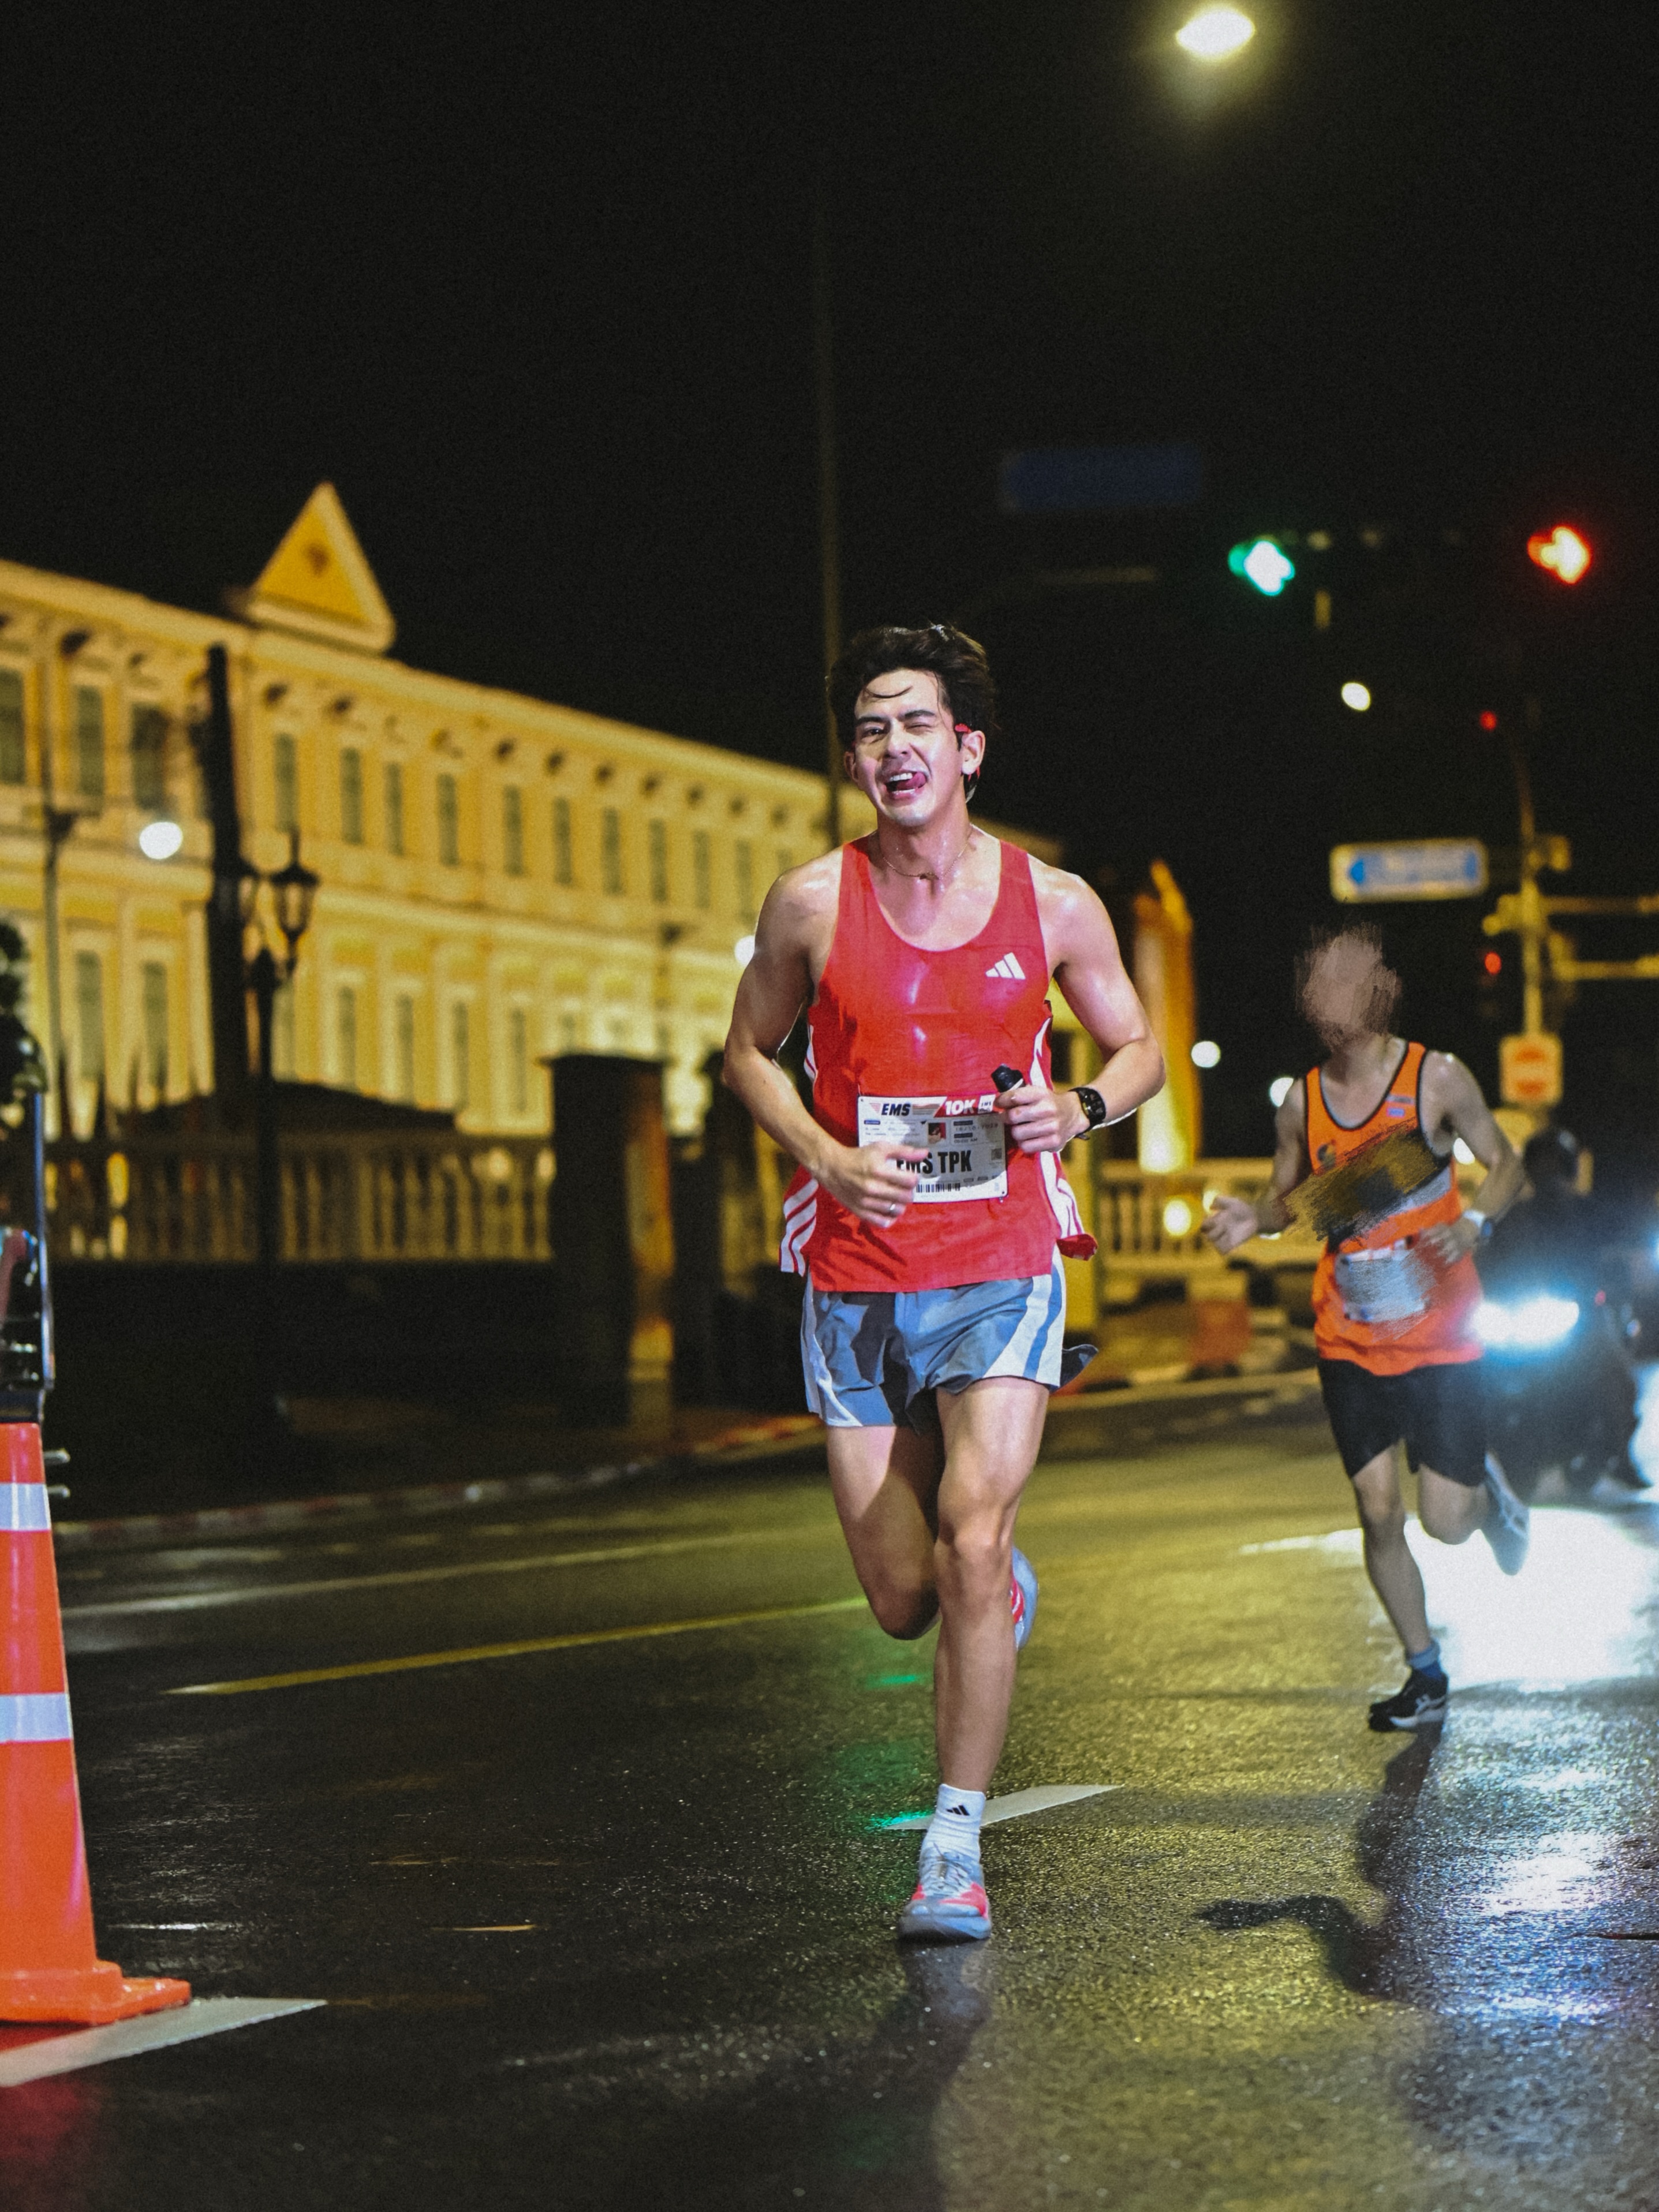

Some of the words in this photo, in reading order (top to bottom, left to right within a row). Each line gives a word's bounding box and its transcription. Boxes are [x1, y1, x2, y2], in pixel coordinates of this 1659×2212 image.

[881, 1103, 911, 1116] EMS
[944, 1099, 976, 1115] 10K
[937, 1150, 972, 1174] TPK
